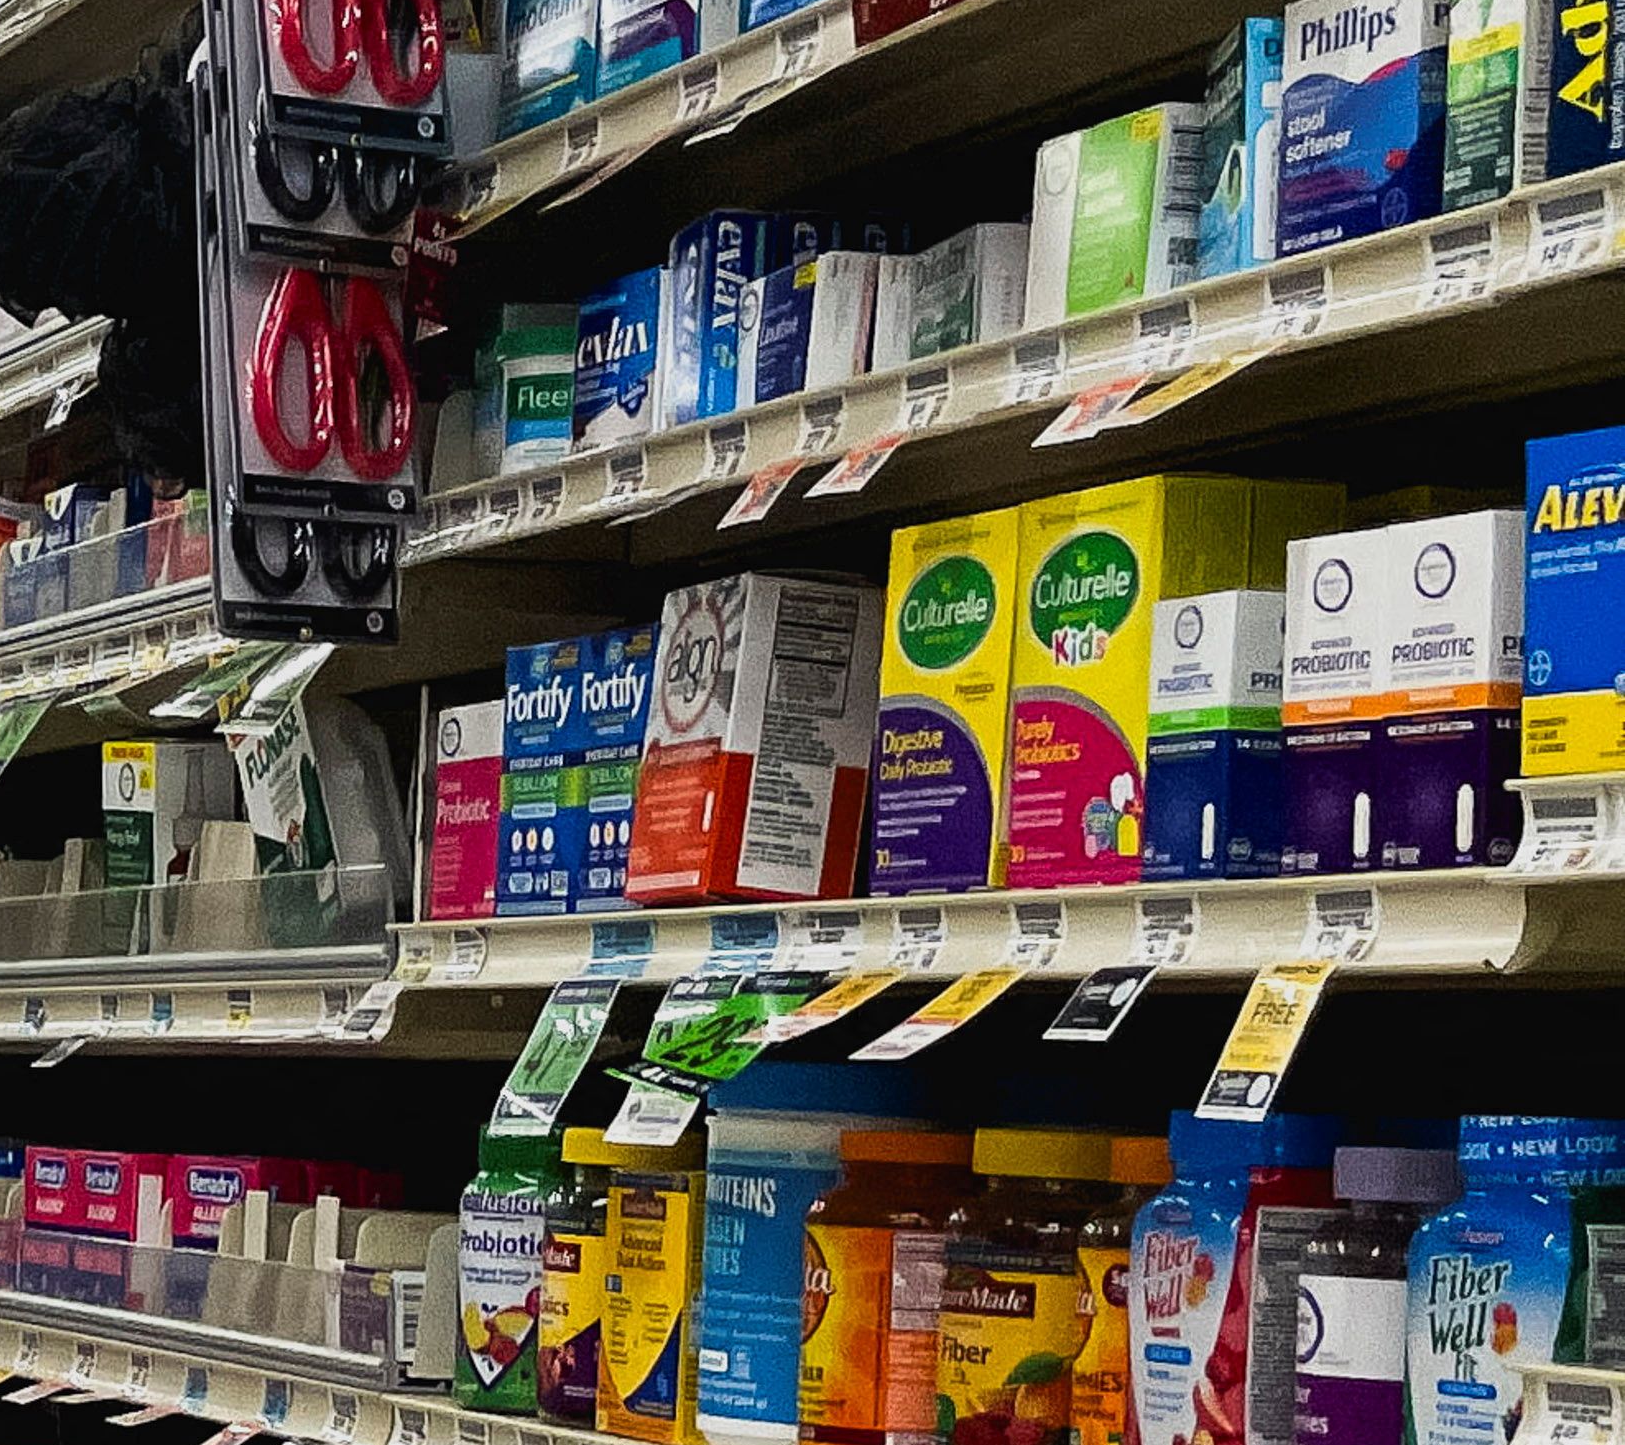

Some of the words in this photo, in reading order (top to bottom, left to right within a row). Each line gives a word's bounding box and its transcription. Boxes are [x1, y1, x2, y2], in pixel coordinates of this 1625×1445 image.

[1285, 130, 1352, 166] softener
[1034, 566, 1132, 610] Culturelle
[902, 593, 989, 635] Culturelle
[1052, 628, 1108, 667] Kids
[1291, 650, 1371, 676] PROBIOTIC
[1391, 638, 1474, 664] PROBIOTIC
[506, 676, 573, 727] Fortify
[581, 665, 647, 715] Fortify
[882, 730, 943, 754] Digestive
[436, 798, 491, 825] Probiotic
[1251, 1001, 1301, 1026] FREE
[1512, 1141, 1558, 1157] NEW
[1563, 1137, 1617, 1155] LOOK
[189, 1171, 241, 1203] Benadryl
[1143, 1231, 1200, 1278] Fiber
[1429, 1254, 1512, 1305] Fiber
[1429, 1302, 1488, 1356] Well
